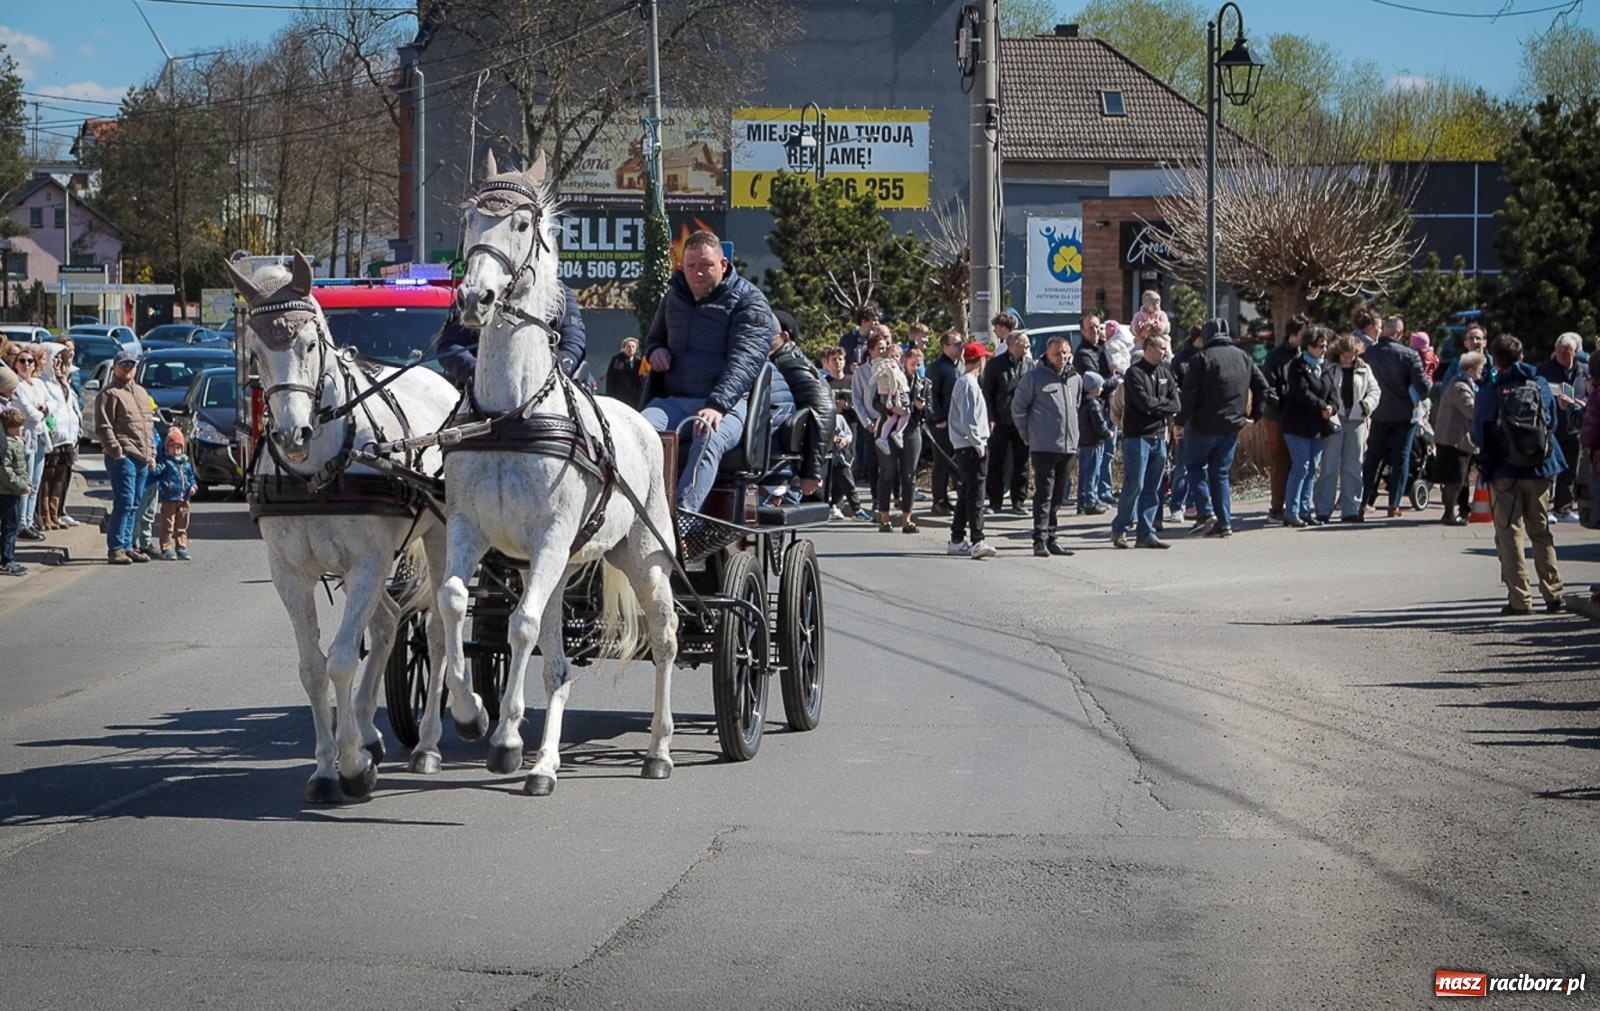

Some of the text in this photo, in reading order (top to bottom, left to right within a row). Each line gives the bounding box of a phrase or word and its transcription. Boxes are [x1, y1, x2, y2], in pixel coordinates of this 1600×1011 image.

[828, 125, 850, 142] NA
[855, 125, 914, 148] TWOJĄ
[865, 178, 905, 201] 255
[587, 260, 617, 278] 506
